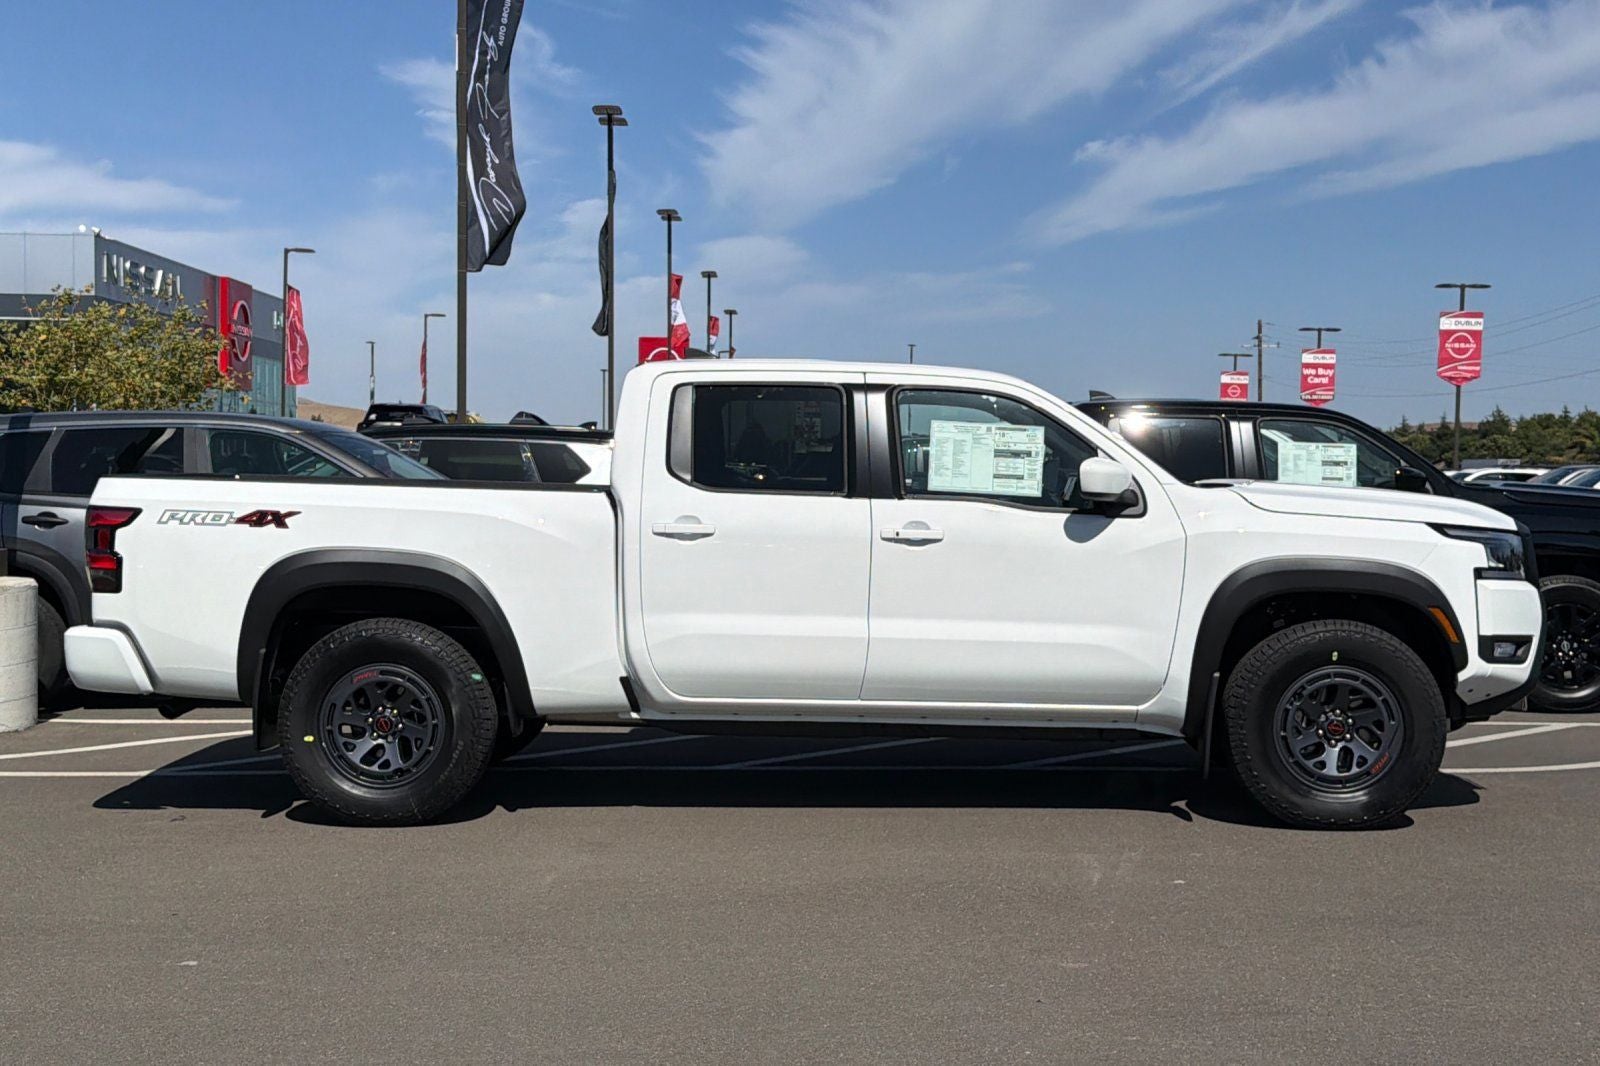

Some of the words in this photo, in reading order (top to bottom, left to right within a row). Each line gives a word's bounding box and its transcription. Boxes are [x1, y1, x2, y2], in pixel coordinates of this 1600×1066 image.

[501, 0, 512, 24] GROU
[498, 25, 507, 46] AUTO
[1302, 367, 1317, 375] We
[1317, 367, 1335, 377] Buy
